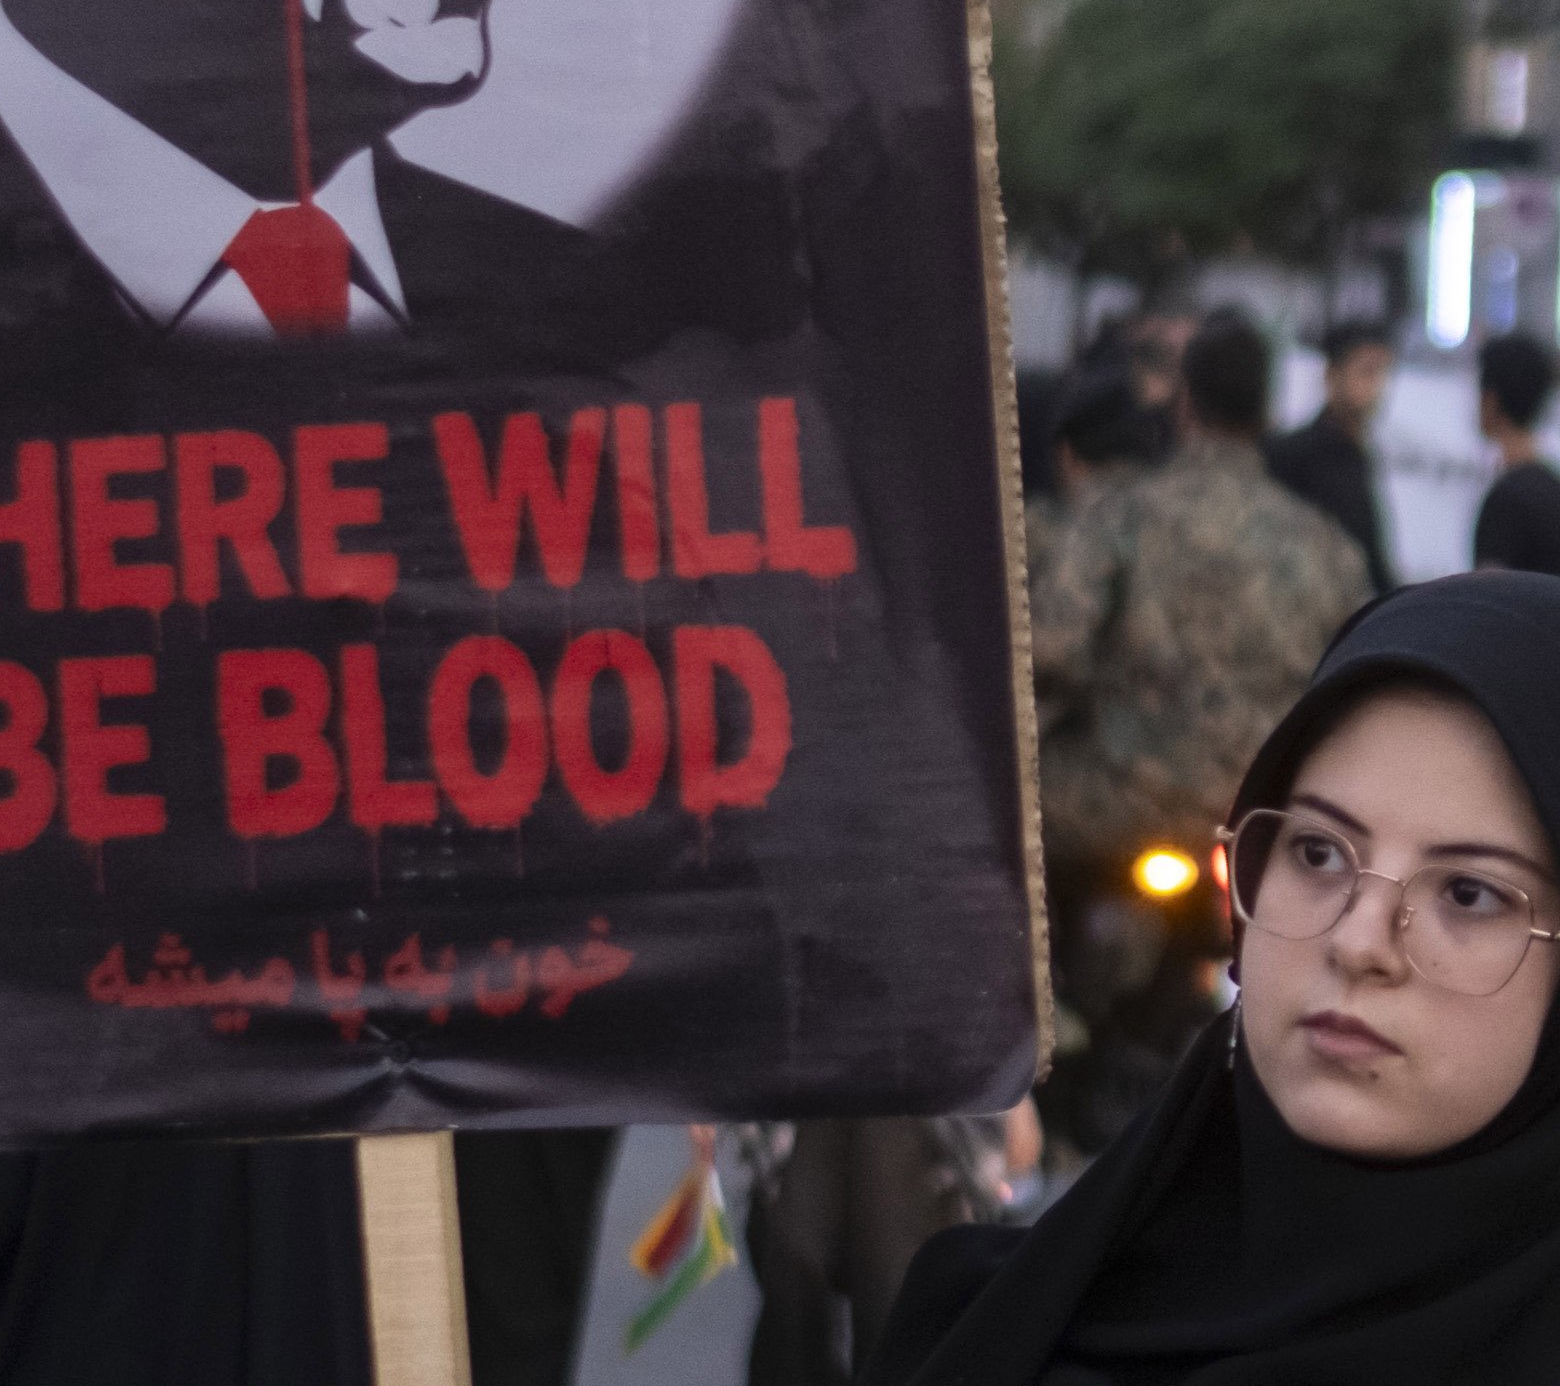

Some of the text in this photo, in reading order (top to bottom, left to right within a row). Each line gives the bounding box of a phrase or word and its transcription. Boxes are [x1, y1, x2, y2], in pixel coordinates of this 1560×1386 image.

[432, 397, 856, 593] WILL
[217, 624, 792, 839] BLOOD
[86, 916, 636, 1041] خون به پا میشه
